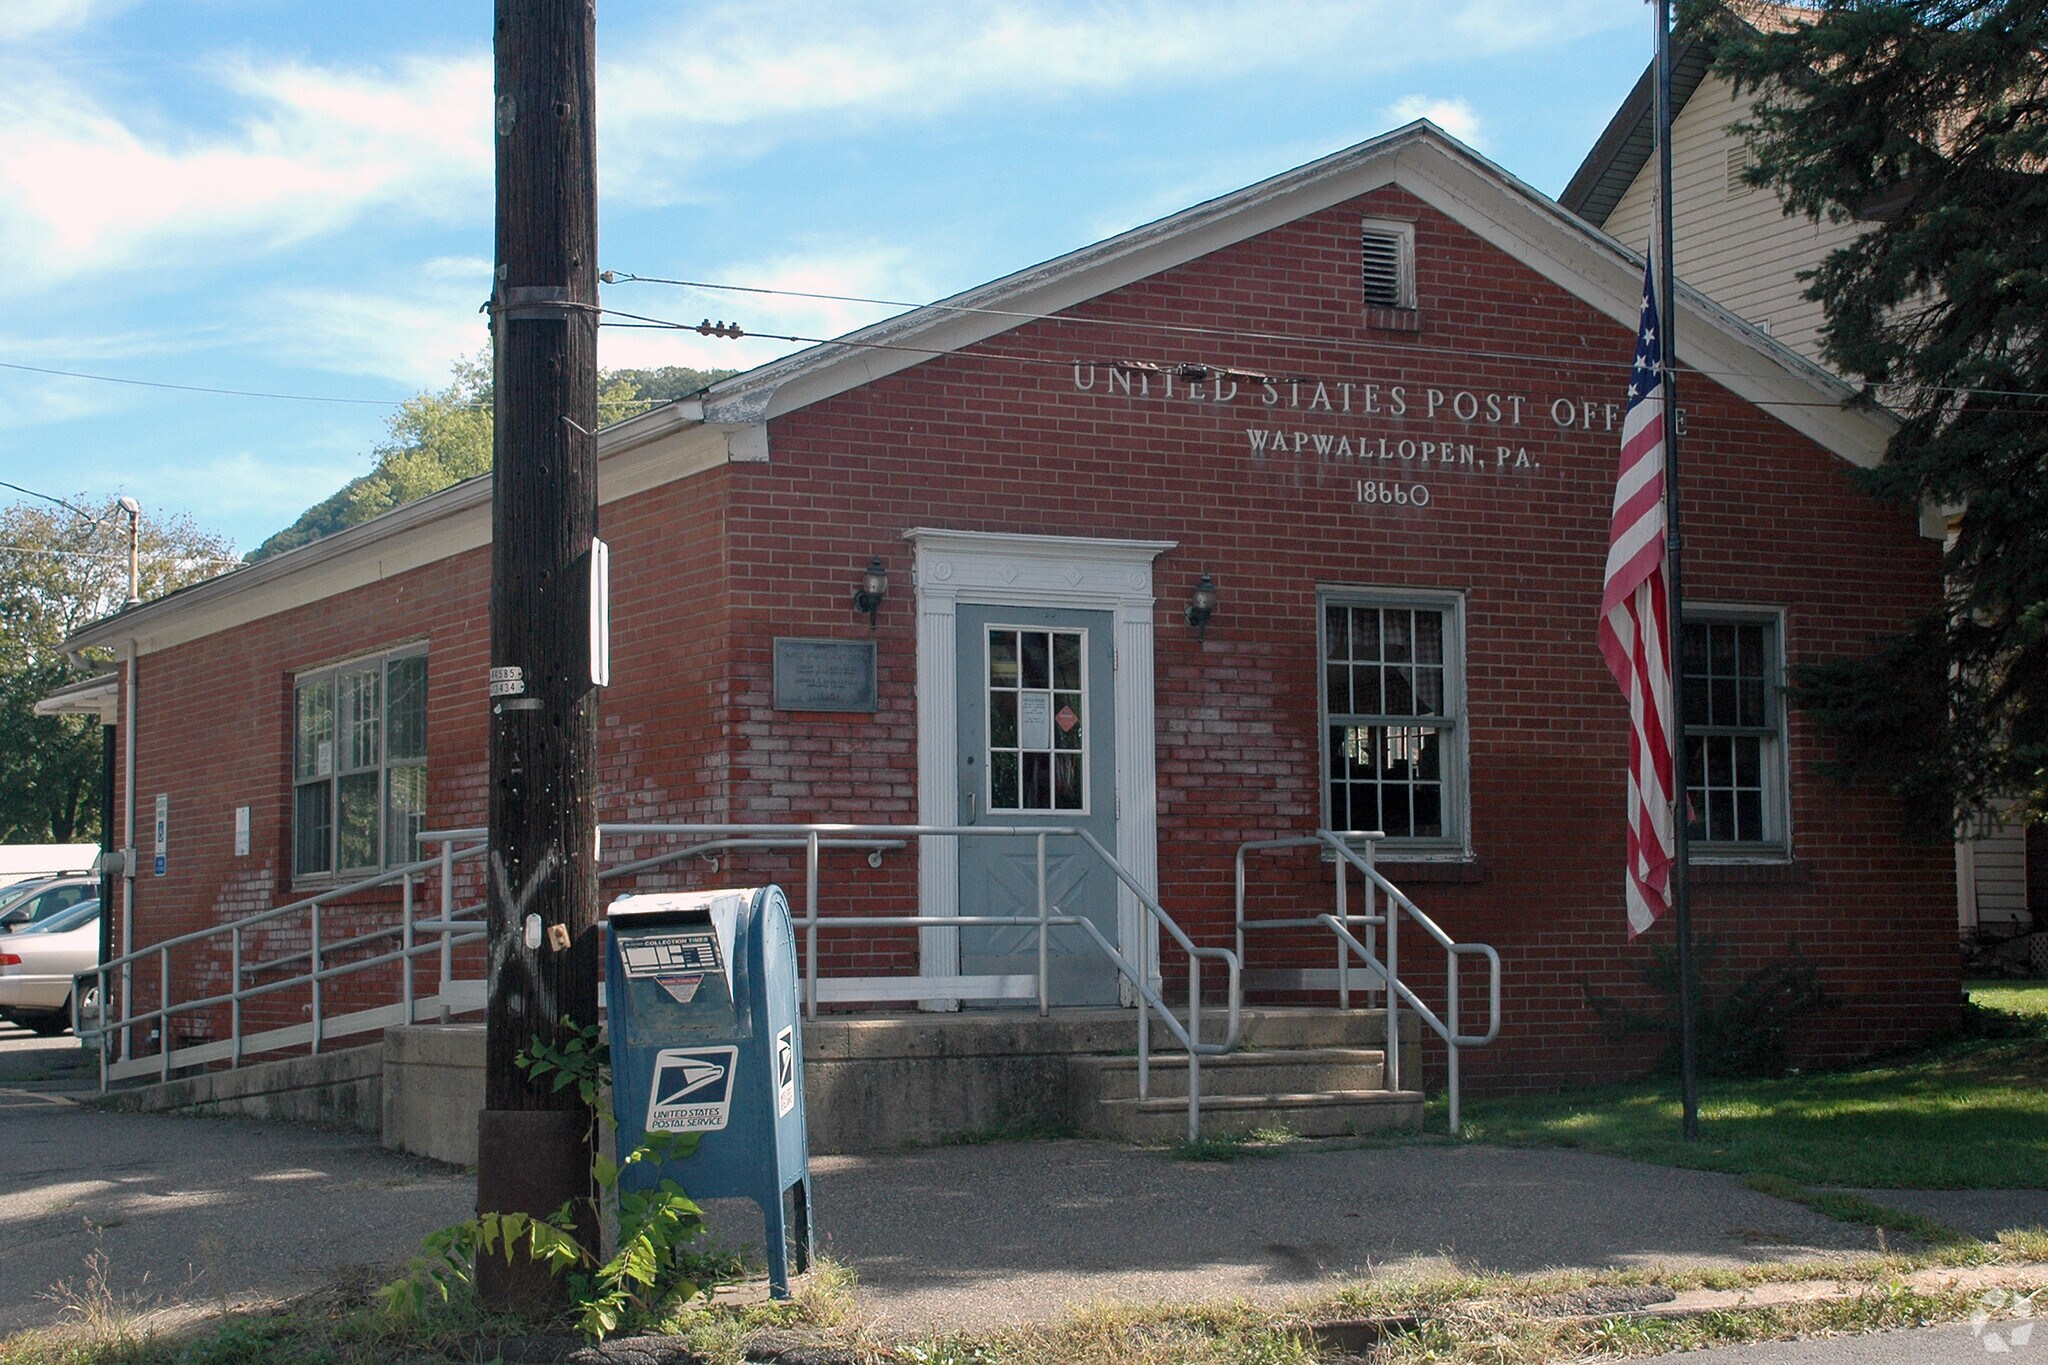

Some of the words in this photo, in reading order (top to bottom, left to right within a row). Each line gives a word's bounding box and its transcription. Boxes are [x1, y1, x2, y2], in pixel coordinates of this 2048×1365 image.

[1261, 377, 1406, 416] STATES
[1426, 388, 1526, 425] POST
[1551, 398, 1688, 436] OFFE
[1246, 428, 1485, 468] WAPWALLOPEN,
[1496, 446, 1540, 468] PA.
[1357, 480, 1429, 506] 18660
[644, 938, 687, 946] COLLECTION
[652, 1119, 686, 1128] POSTAL
[687, 1116, 722, 1127] SERVICE
[653, 1109, 688, 1119] UNITED
[689, 1107, 720, 1117] STATES
